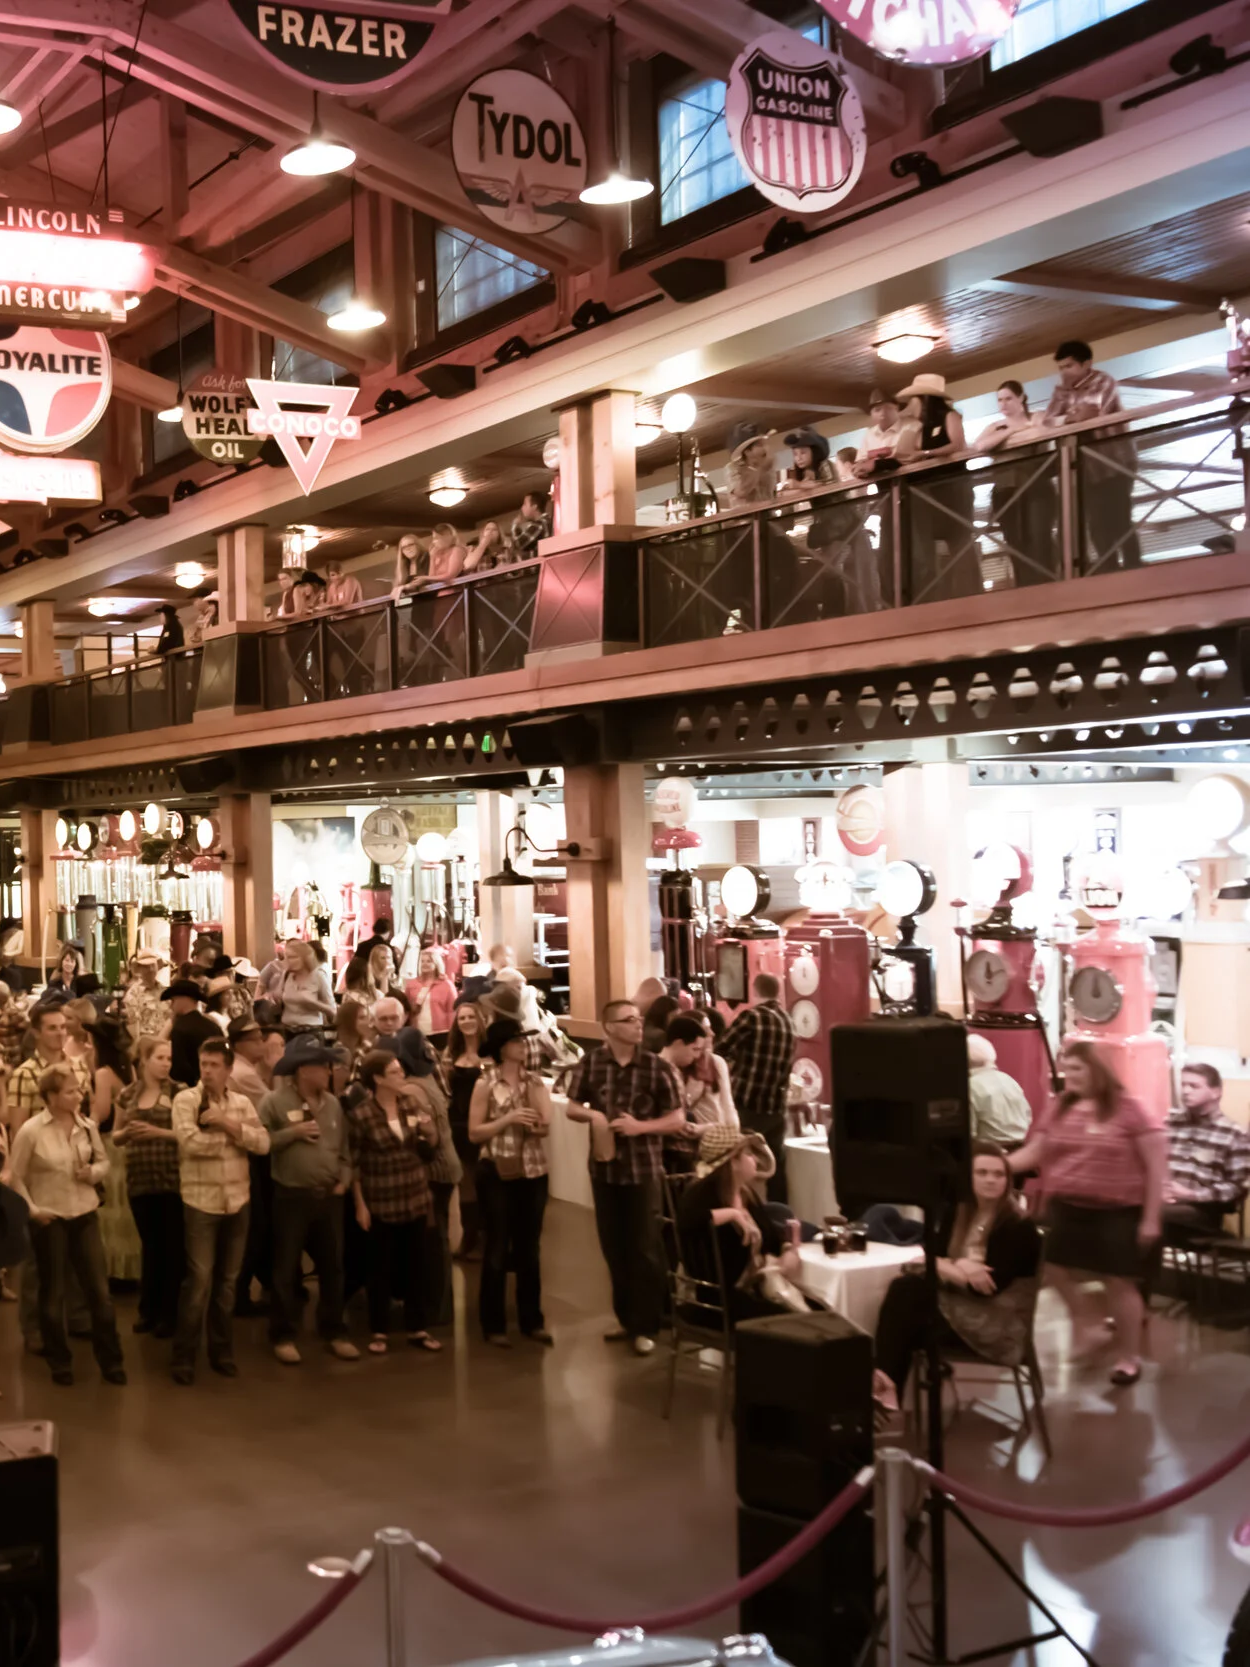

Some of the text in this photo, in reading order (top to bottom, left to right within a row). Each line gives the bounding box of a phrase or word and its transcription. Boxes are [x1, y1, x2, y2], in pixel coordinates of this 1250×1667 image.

[257, 5, 407, 60] FRAZER
[757, 68, 831, 100] UNION
[755, 95, 835, 121] GASOLINE
[468, 92, 582, 168] TYDOL
[250, 411, 359, 437] CONOCO
[211, 442, 244, 458] OIL
